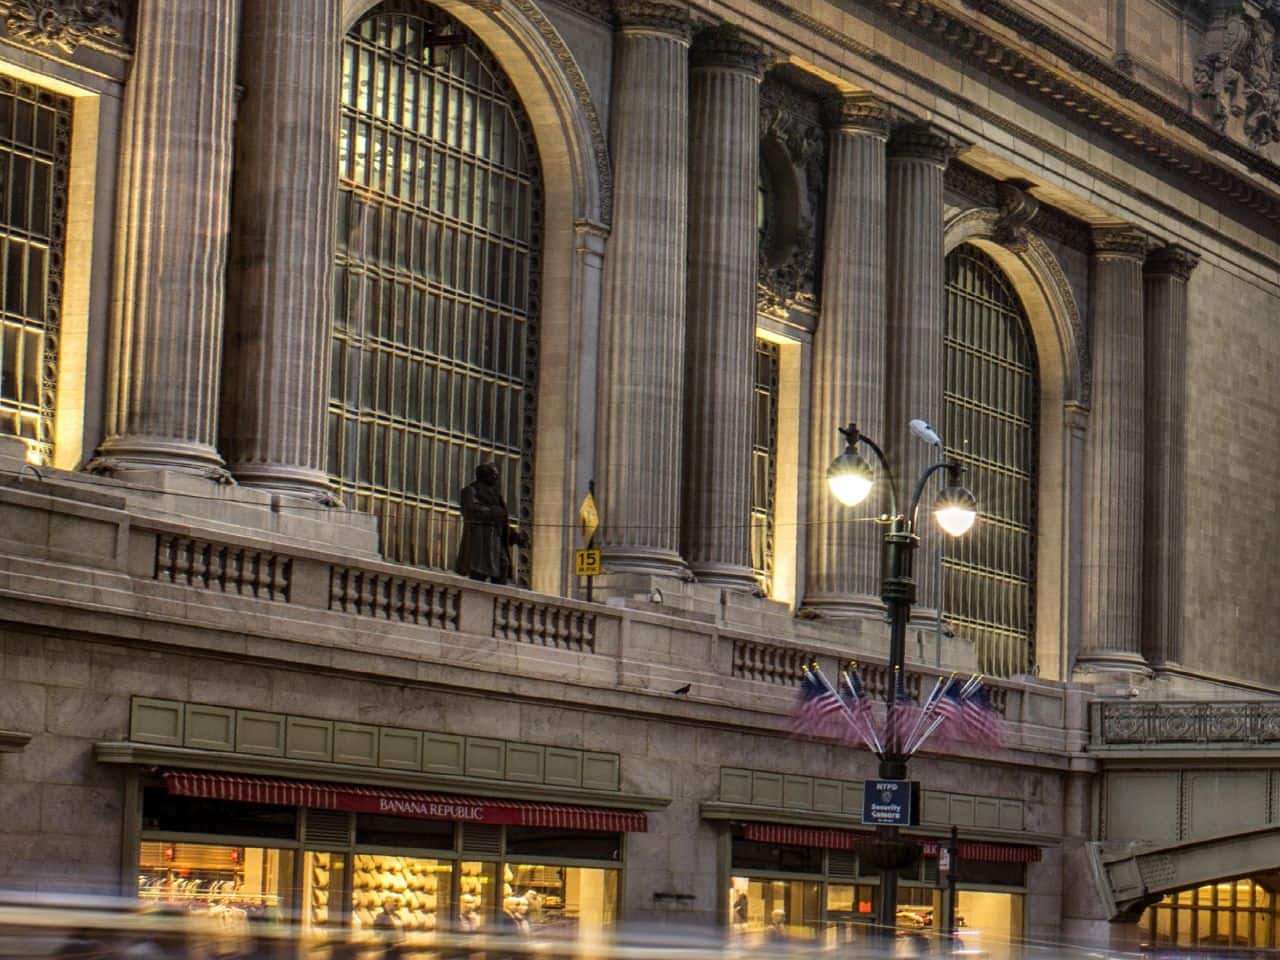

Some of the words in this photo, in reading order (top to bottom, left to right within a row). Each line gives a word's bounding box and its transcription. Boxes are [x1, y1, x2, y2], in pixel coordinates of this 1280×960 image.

[579, 552, 596, 566] 15
[380, 798, 428, 815] BANANA
[430, 803, 484, 820] REPUBLIC
